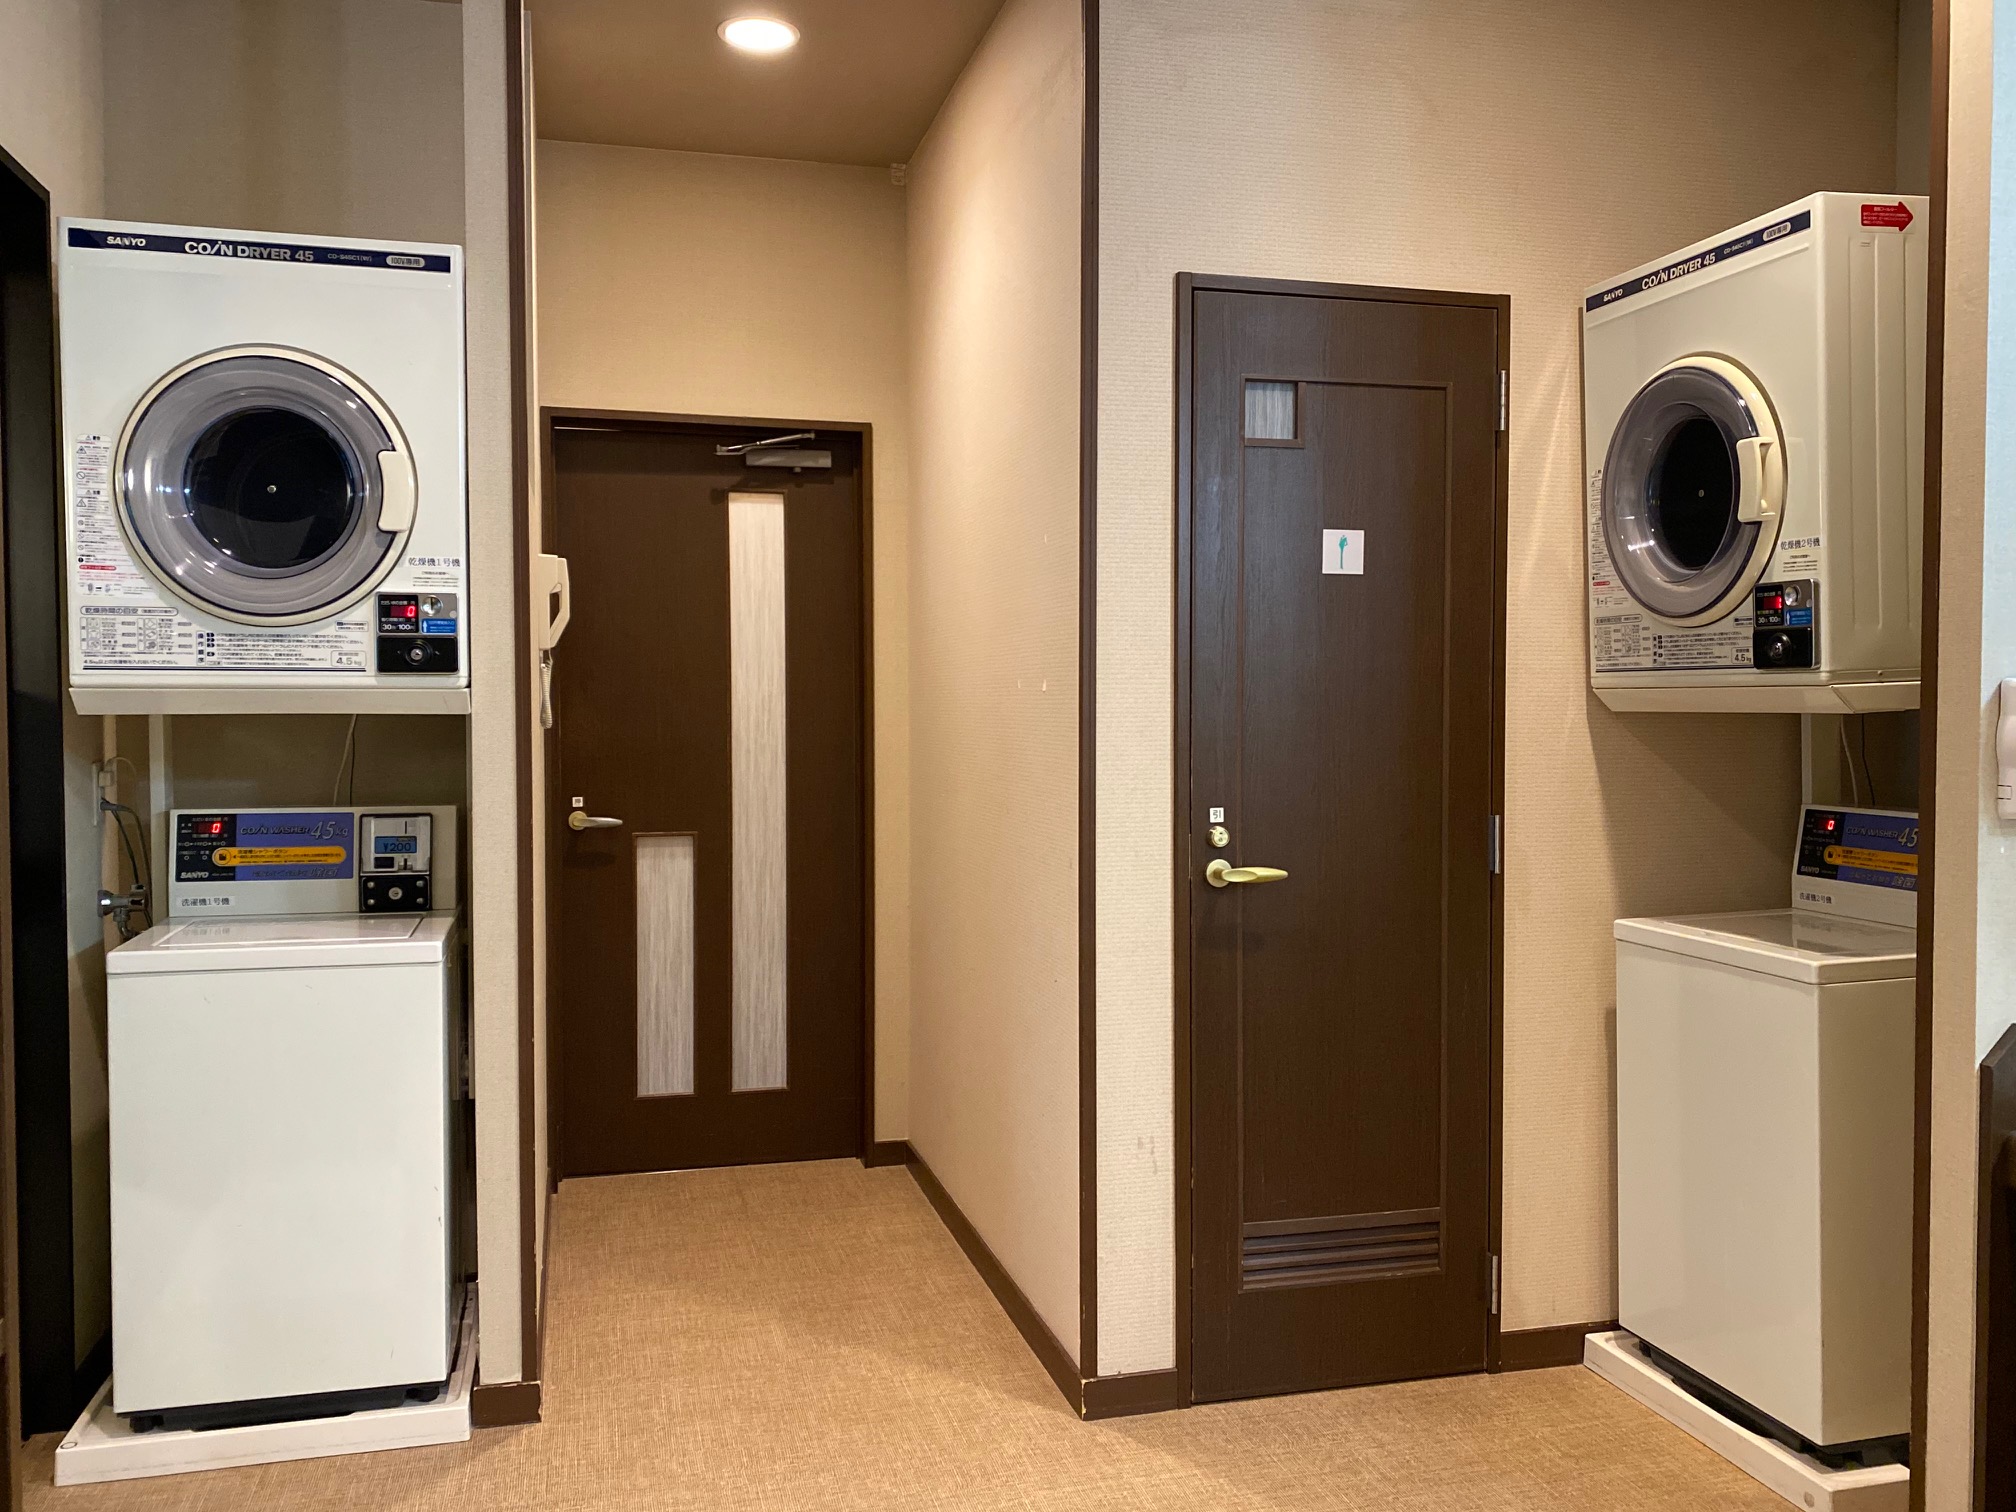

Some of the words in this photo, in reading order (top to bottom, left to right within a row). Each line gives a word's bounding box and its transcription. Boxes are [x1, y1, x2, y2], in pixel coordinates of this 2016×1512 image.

[106, 236, 146, 247] SANYO
[237, 245, 291, 262] DRYER
[294, 250, 314, 262] 45
[1669, 257, 1702, 280] DRYER
[1703, 252, 1716, 267] 45
[1603, 288, 1623, 302] SANYO
[1780, 537, 1821, 551] 乾燥機2号機
[408, 557, 461, 567] 乾燥機1号機
[406, 605, 416, 617] 0
[336, 656, 353, 666] 4.5
[1734, 653, 1747, 662] 4.5
[211, 822, 221, 834] 0
[269, 825, 310, 835] WASHER
[1827, 820, 1835, 831] 0
[1867, 828, 1898, 838] WASHER
[383, 842, 411, 852] ¥200
[1800, 865, 1820, 874] SANYO
[180, 871, 209, 879] SANYO
[181, 897, 230, 907] 洗濯機1号機
